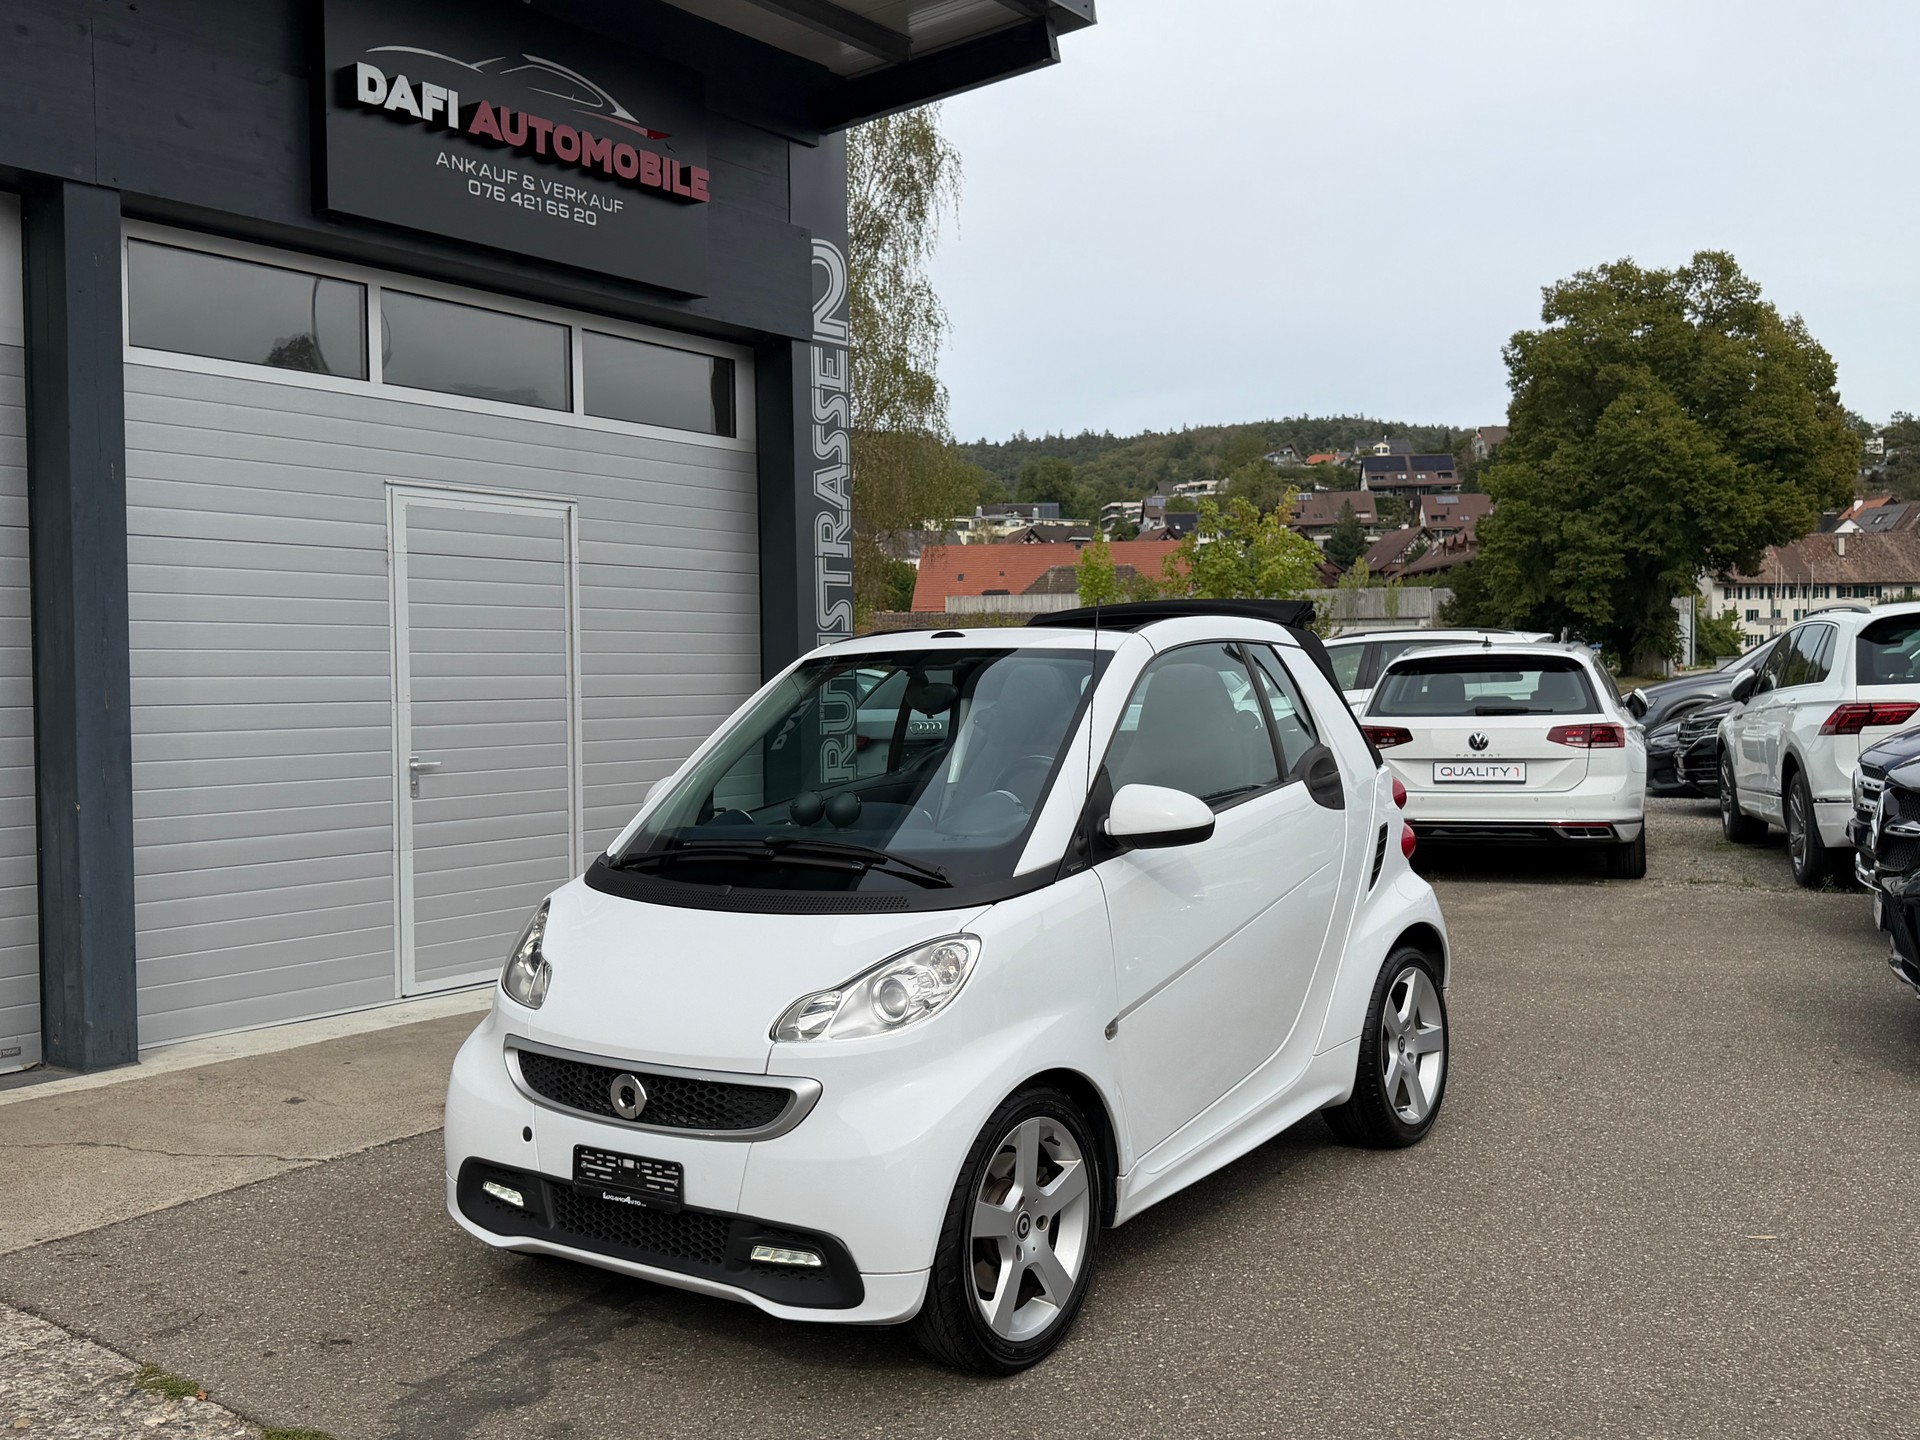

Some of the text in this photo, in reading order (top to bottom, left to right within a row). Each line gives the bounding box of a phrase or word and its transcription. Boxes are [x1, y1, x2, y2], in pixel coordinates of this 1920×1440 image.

[356, 61, 711, 203] DAFI AUTOMOBILE
[435, 151, 625, 214] ANKAUF & VERKAUF
[468, 179, 597, 227] 076 421 65 20
[1440, 767, 1520, 777] QUALITY 1
